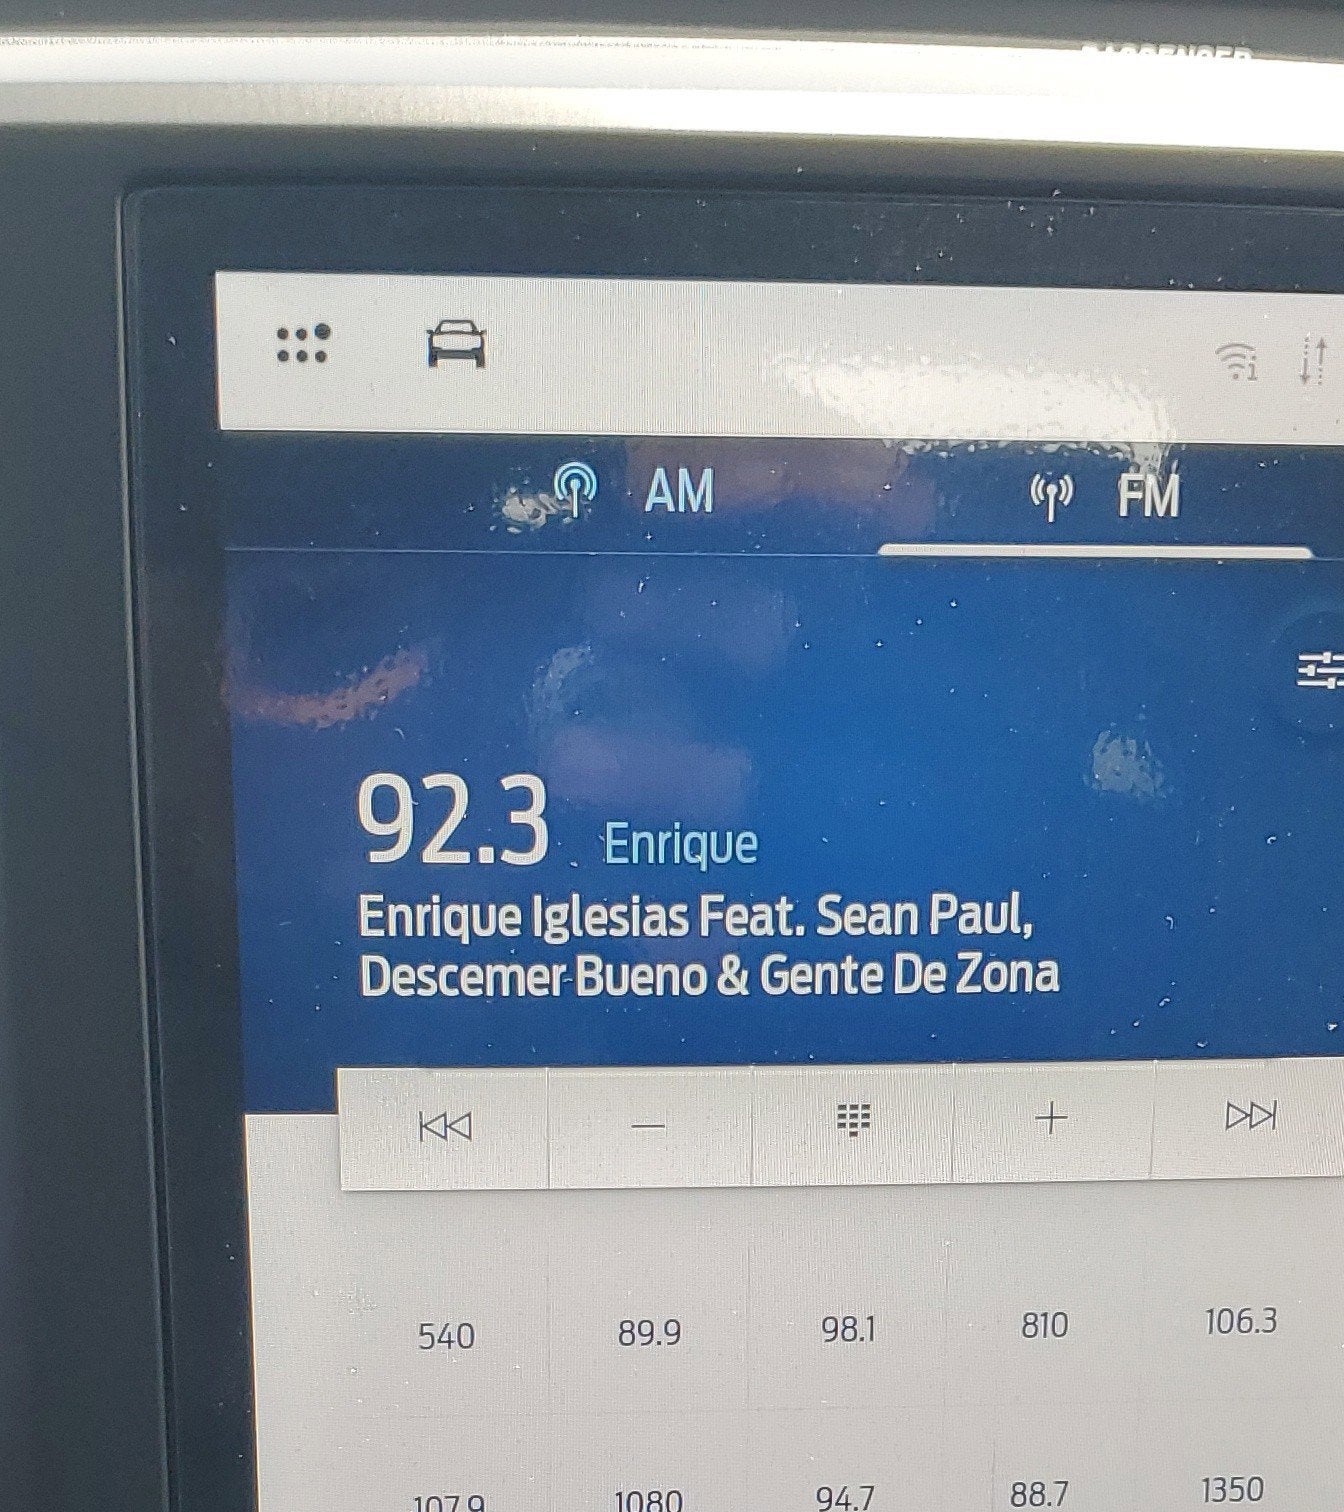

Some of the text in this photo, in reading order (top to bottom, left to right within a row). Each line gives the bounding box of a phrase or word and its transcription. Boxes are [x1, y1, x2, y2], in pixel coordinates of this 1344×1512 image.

[645, 468, 713, 514] AM
[1118, 473, 1180, 519] FM
[356, 771, 549, 866] 92.3
[604, 820, 760, 871] Enrique
[358, 890, 1034, 945] Enrique Iglesias Feat. Sean Paul,
[359, 950, 1061, 998] Descemer Bueno & Gente De Zona
[618, 1318, 682, 1346] 89.9
[821, 1315, 876, 1343] 98.1
[1021, 1311, 1069, 1339] 810
[1205, 1307, 1278, 1335] 106.3
[417, 1322, 476, 1350] 540
[816, 1485, 875, 1512] 94.7
[1010, 1481, 1069, 1508] 88.7
[1201, 1476, 1265, 1503] 1350
